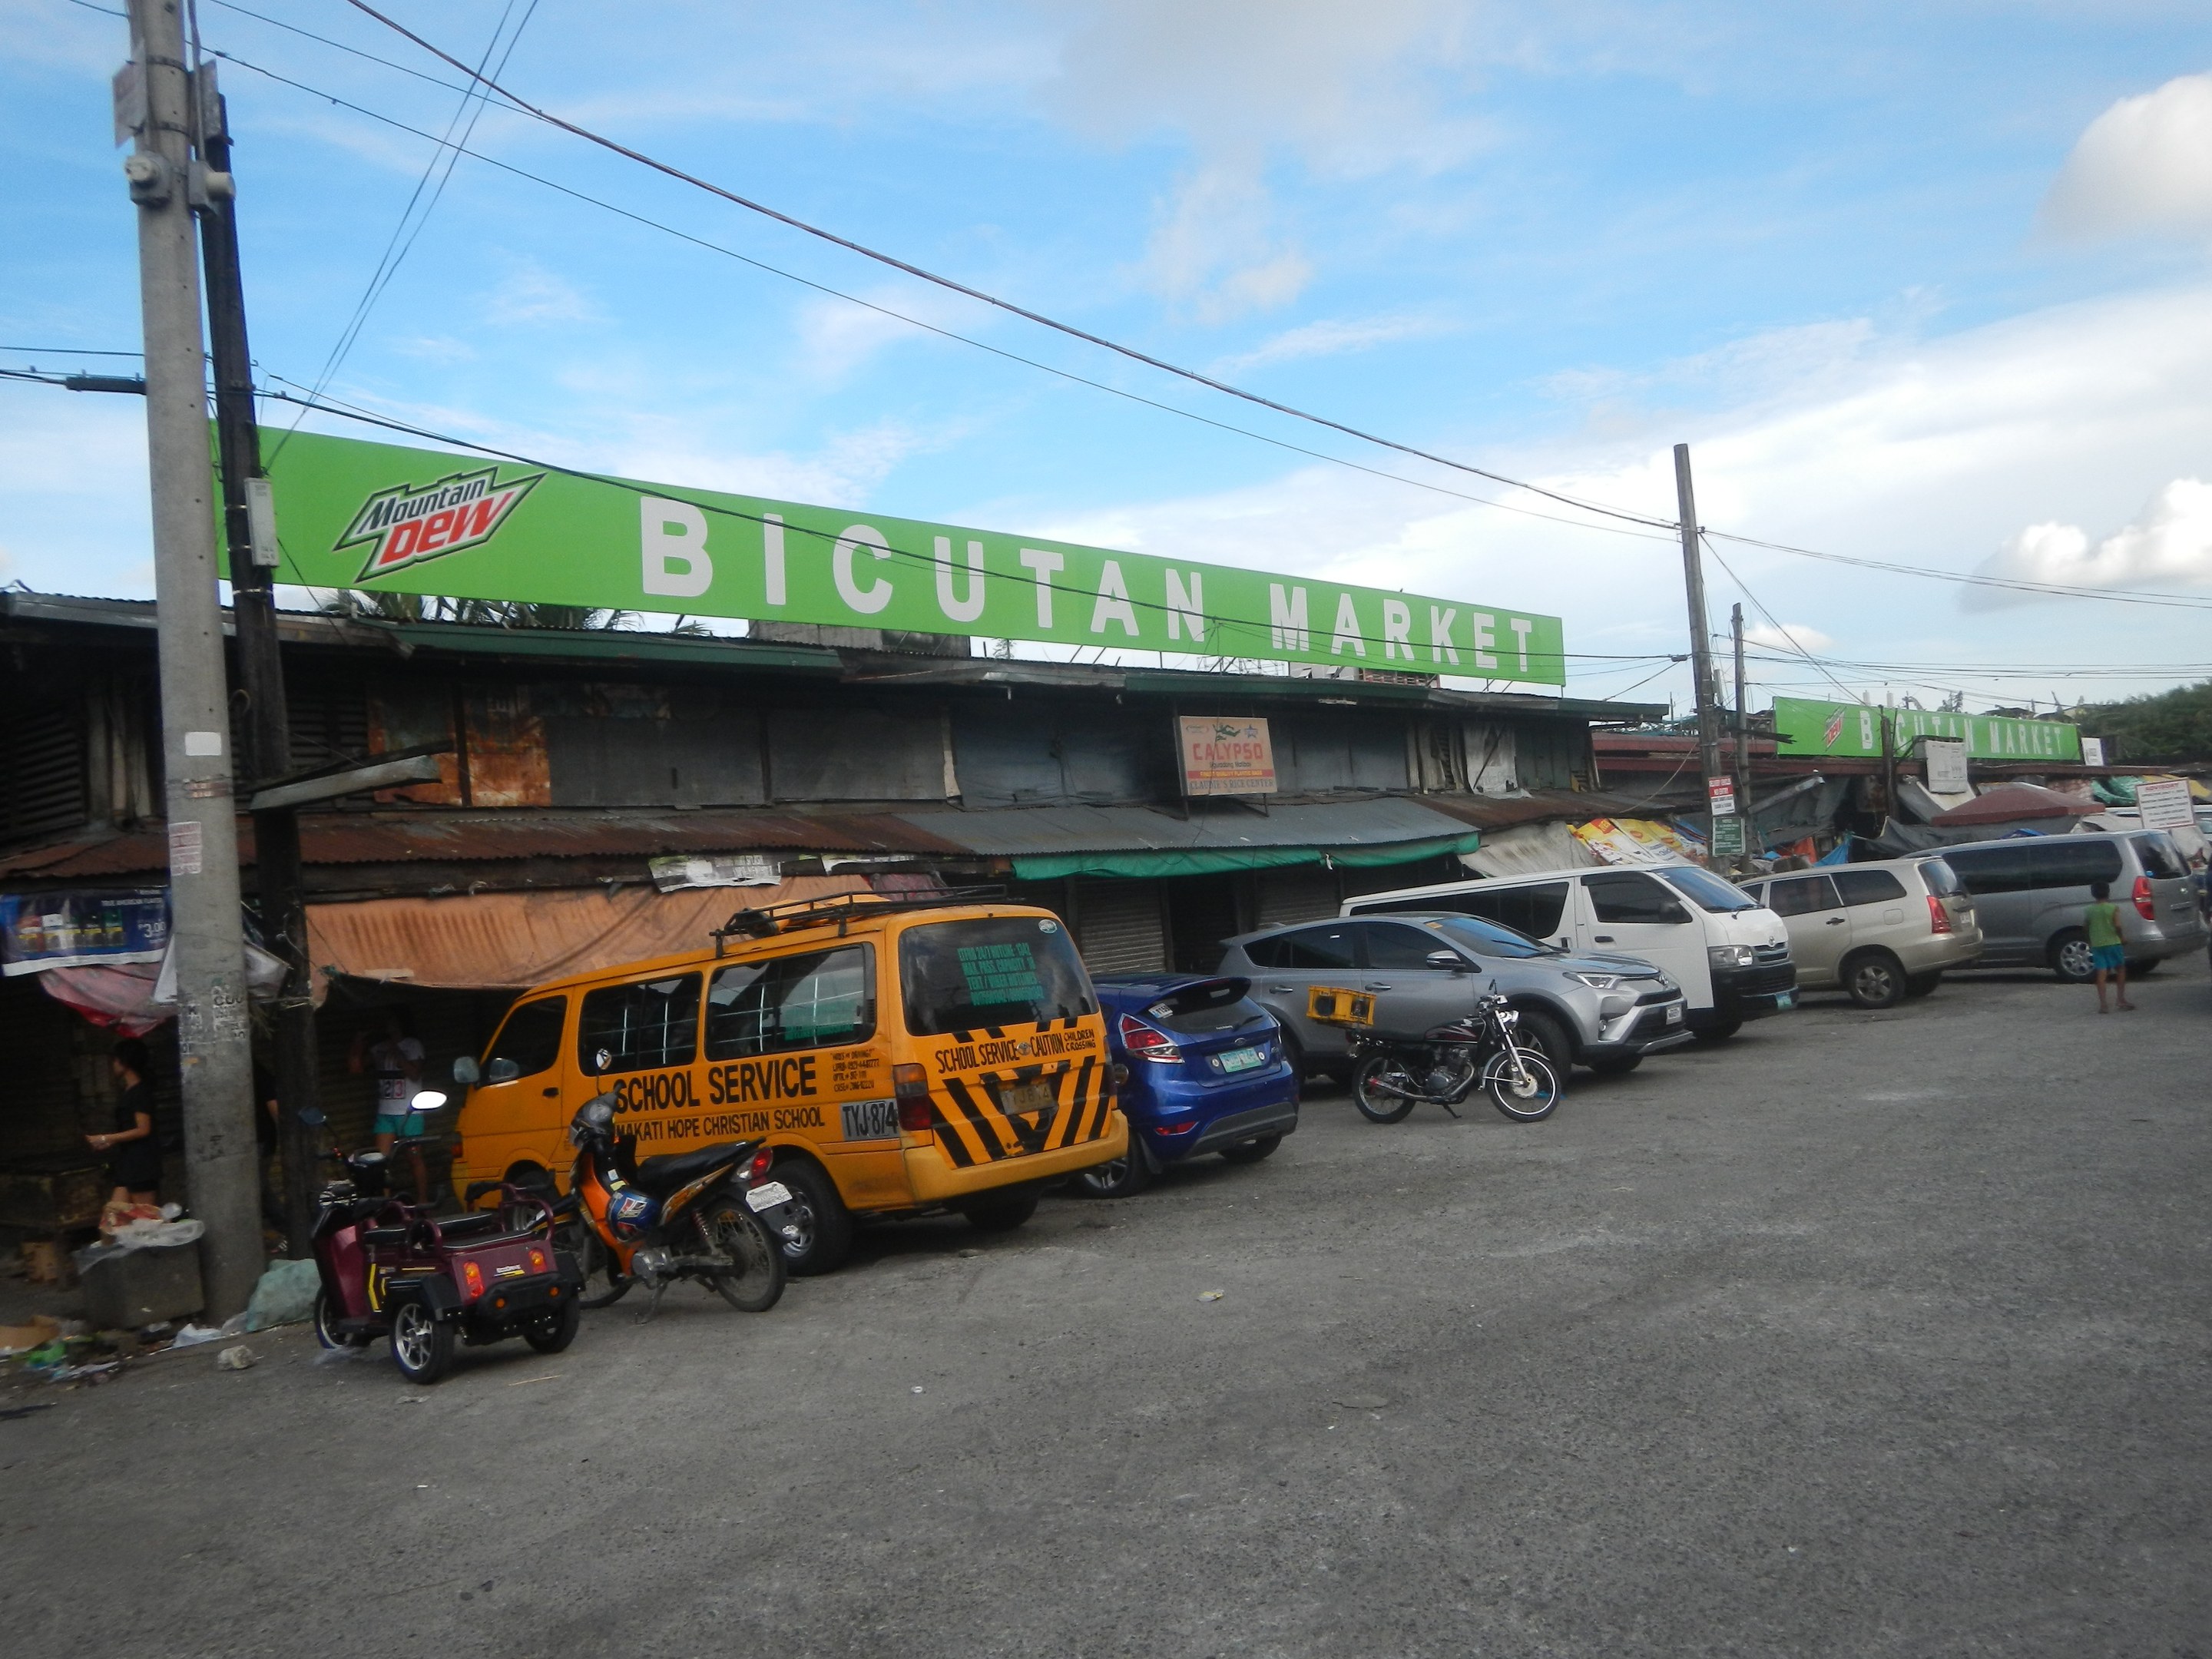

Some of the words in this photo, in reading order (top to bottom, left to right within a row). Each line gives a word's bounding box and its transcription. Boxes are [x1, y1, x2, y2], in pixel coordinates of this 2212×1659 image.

[356, 478, 486, 535] Mountain
[640, 495, 1206, 642] BICUTAN
[1270, 584, 1534, 672] MARKET
[1193, 743, 1263, 760] CALYPSO
[1990, 721, 2061, 755] MARKET
[1246, 779, 1273, 788] CENTER
[1064, 1028, 1094, 1042] CHILDREN
[1065, 1038, 1096, 1052] CROSSING
[935, 1045, 980, 1074] SCHOOL
[979, 1039, 1020, 1066] SERVICE
[1029, 1032, 1065, 1058] CAUTION
[615, 1071, 700, 1114] SCHOOL
[709, 1055, 817, 1105] SERVICE
[615, 1118, 663, 1142] MAKATI
[667, 1117, 700, 1139] HOPE
[704, 1110, 770, 1136] CHRISTIAN
[773, 1106, 826, 1129] SCHOOL
